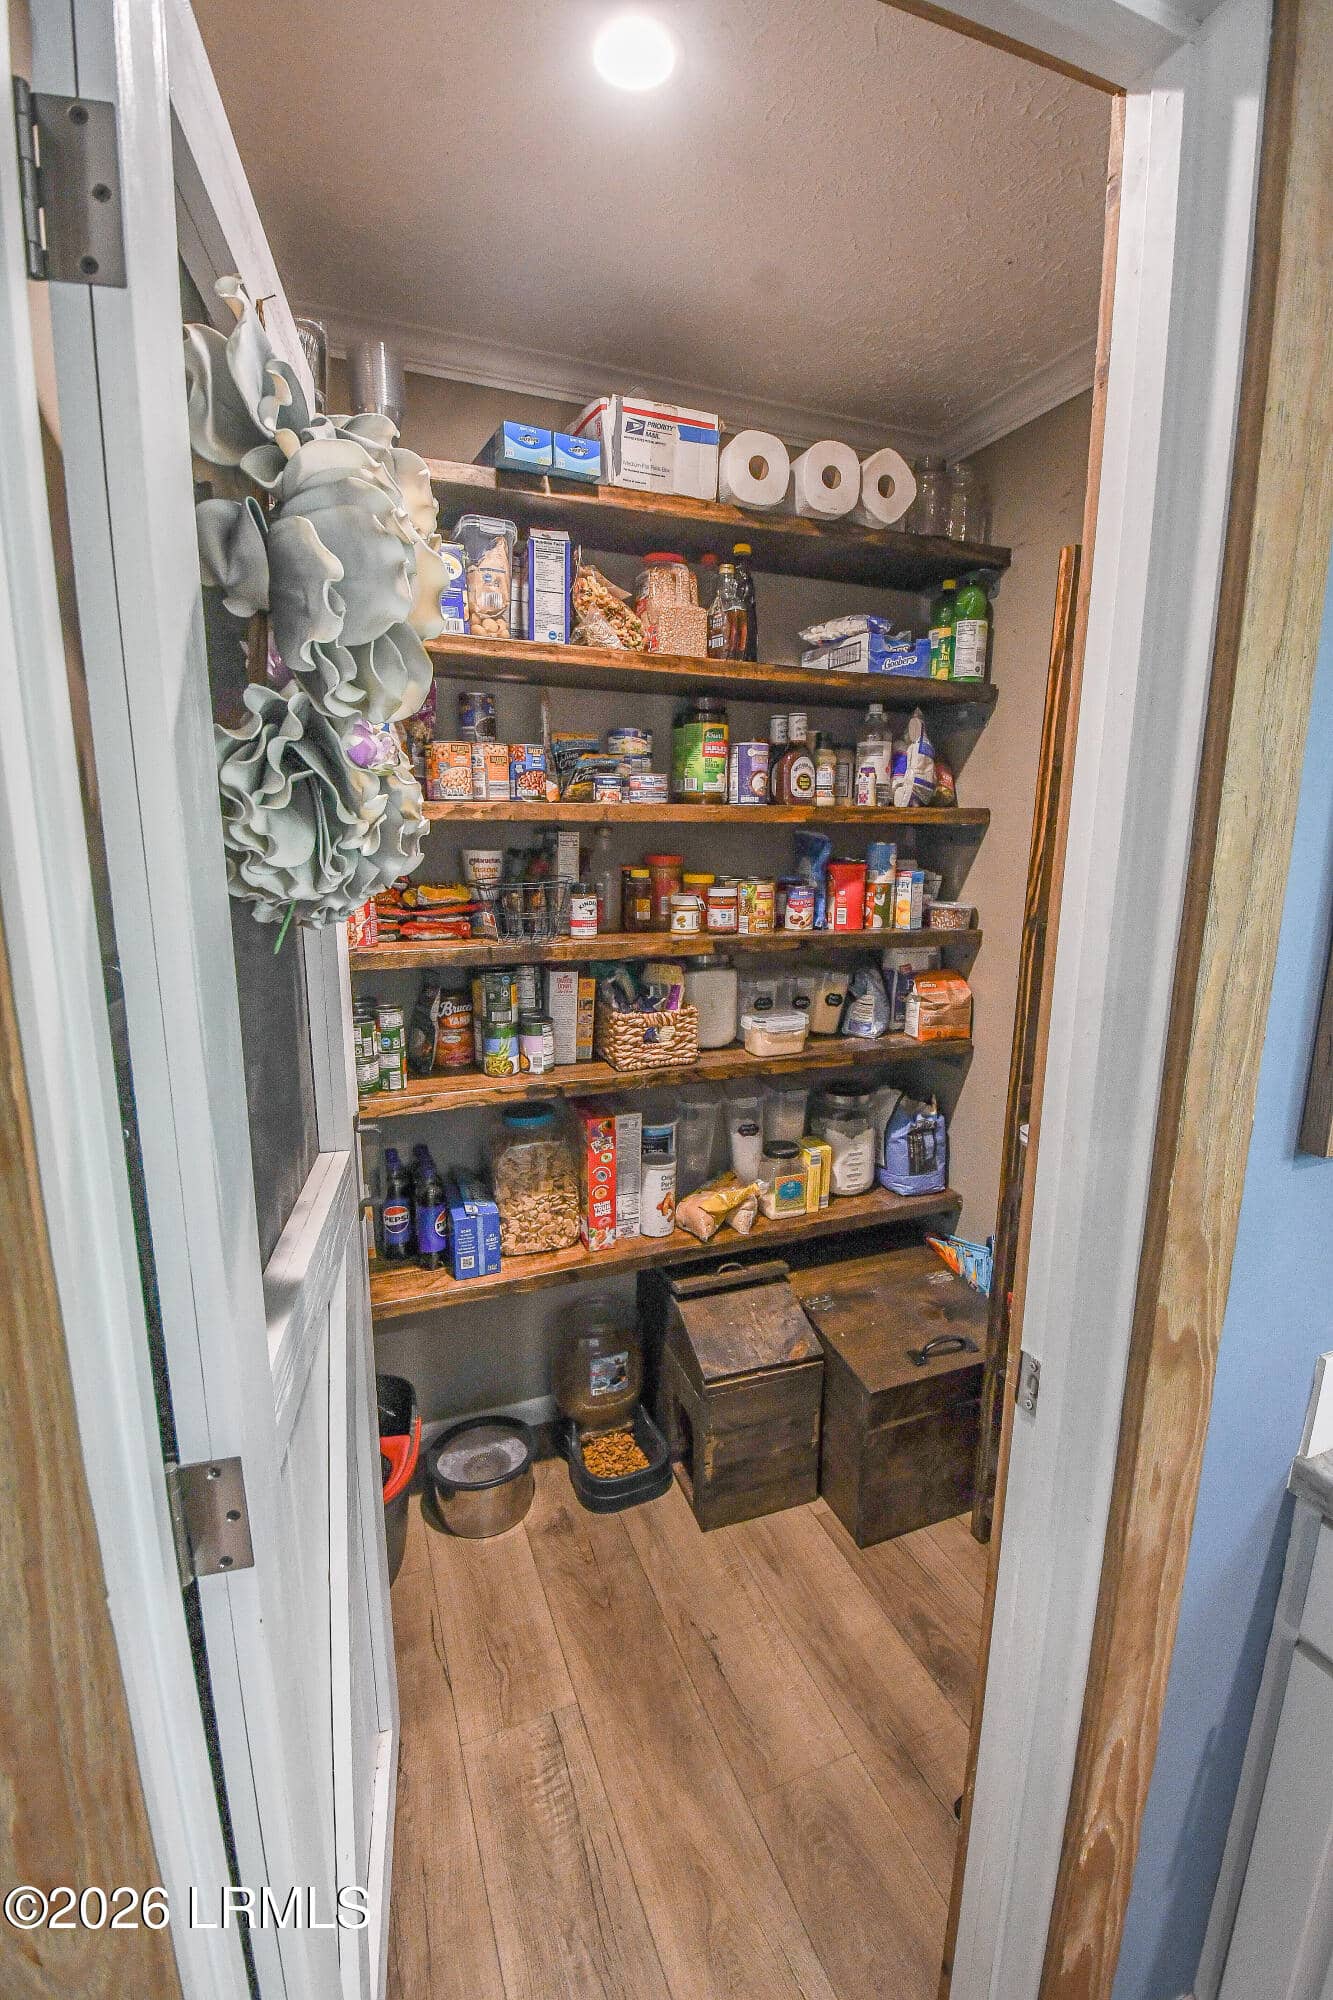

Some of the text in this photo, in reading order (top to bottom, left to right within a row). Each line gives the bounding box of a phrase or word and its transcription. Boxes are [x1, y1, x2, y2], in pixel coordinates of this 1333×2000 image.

[647, 421, 673, 432] PRIORITY
[883, 655, 917, 671] Goobers
[384, 1215, 410, 1224] PEPSI
